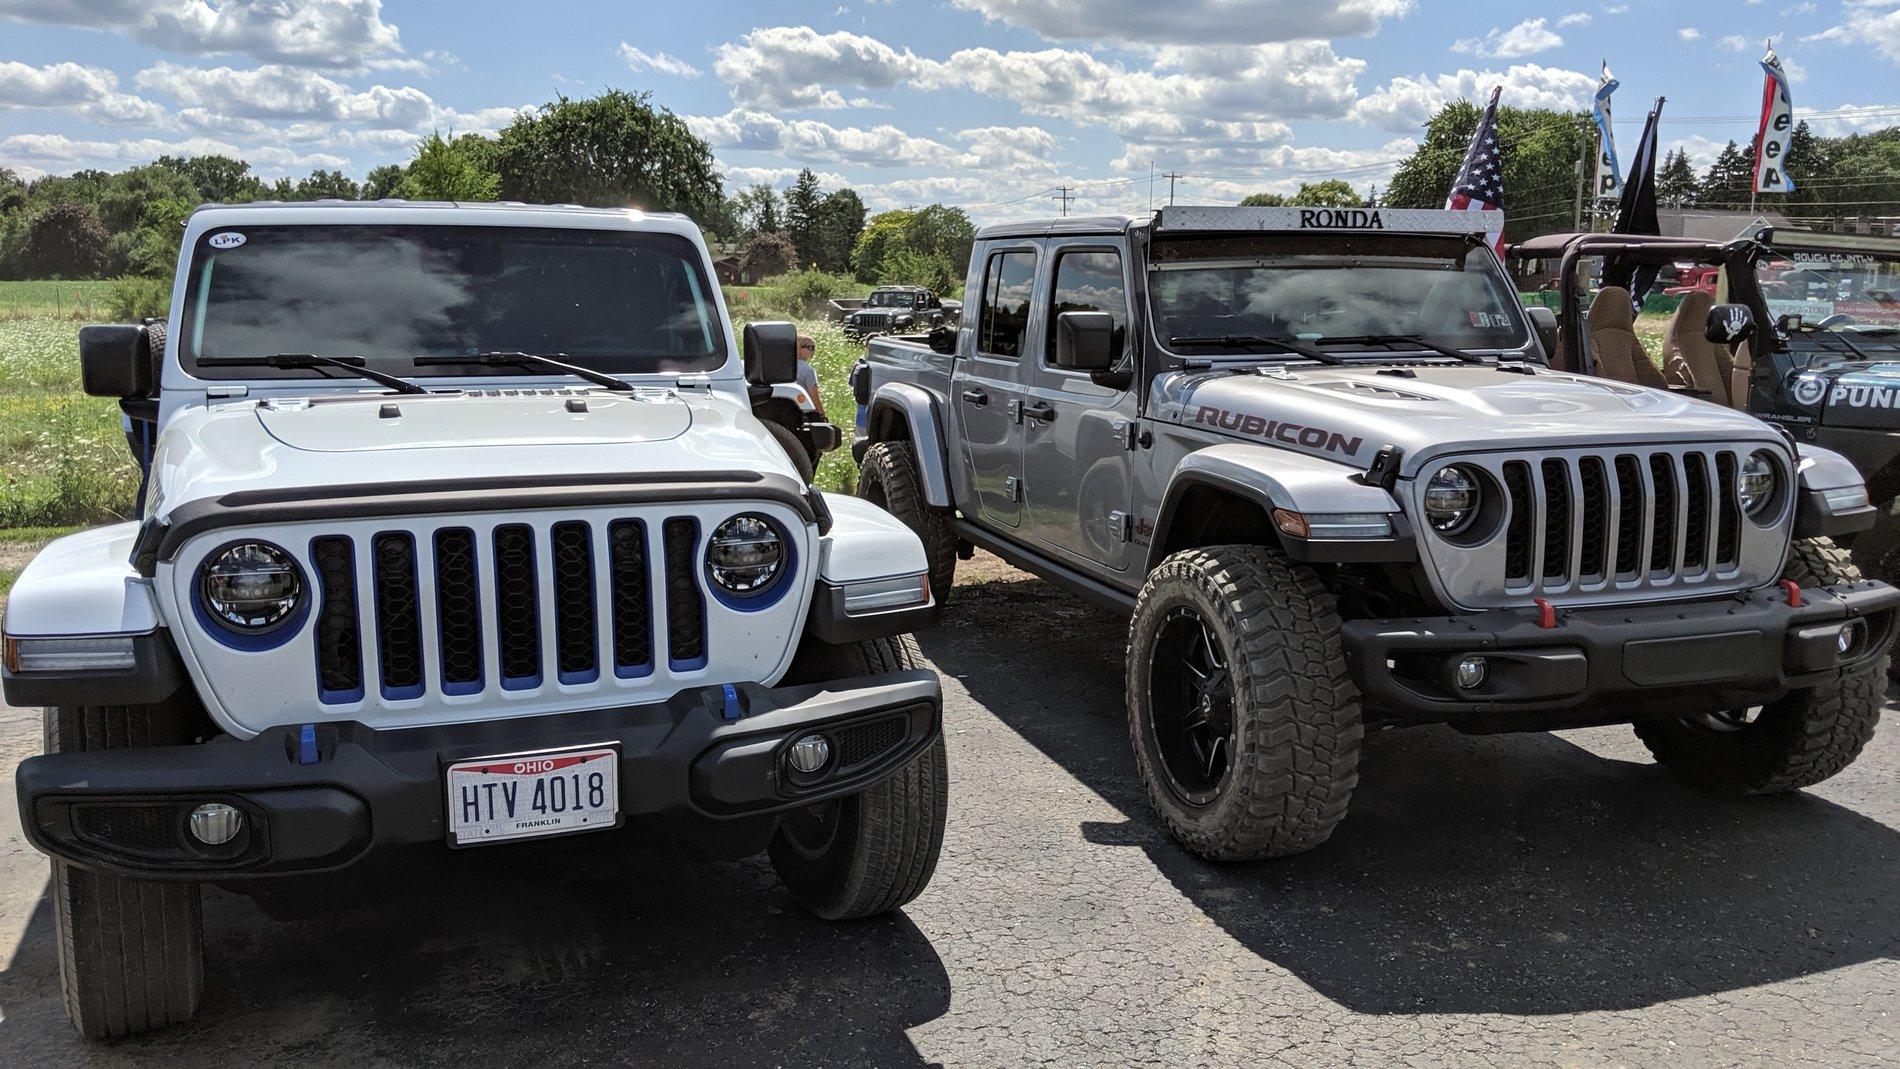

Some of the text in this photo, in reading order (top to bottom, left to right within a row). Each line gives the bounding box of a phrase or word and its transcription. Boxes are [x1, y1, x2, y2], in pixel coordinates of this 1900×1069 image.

[1300, 209, 1384, 229] RONDA
[214, 236, 240, 245] LPK
[1793, 252, 1828, 263] ROUGH
[1195, 405, 1363, 457] RUBICON
[513, 760, 554, 774] OHIO
[462, 772, 604, 823] HTV 4018
[515, 818, 562, 829] FRANKLIN
